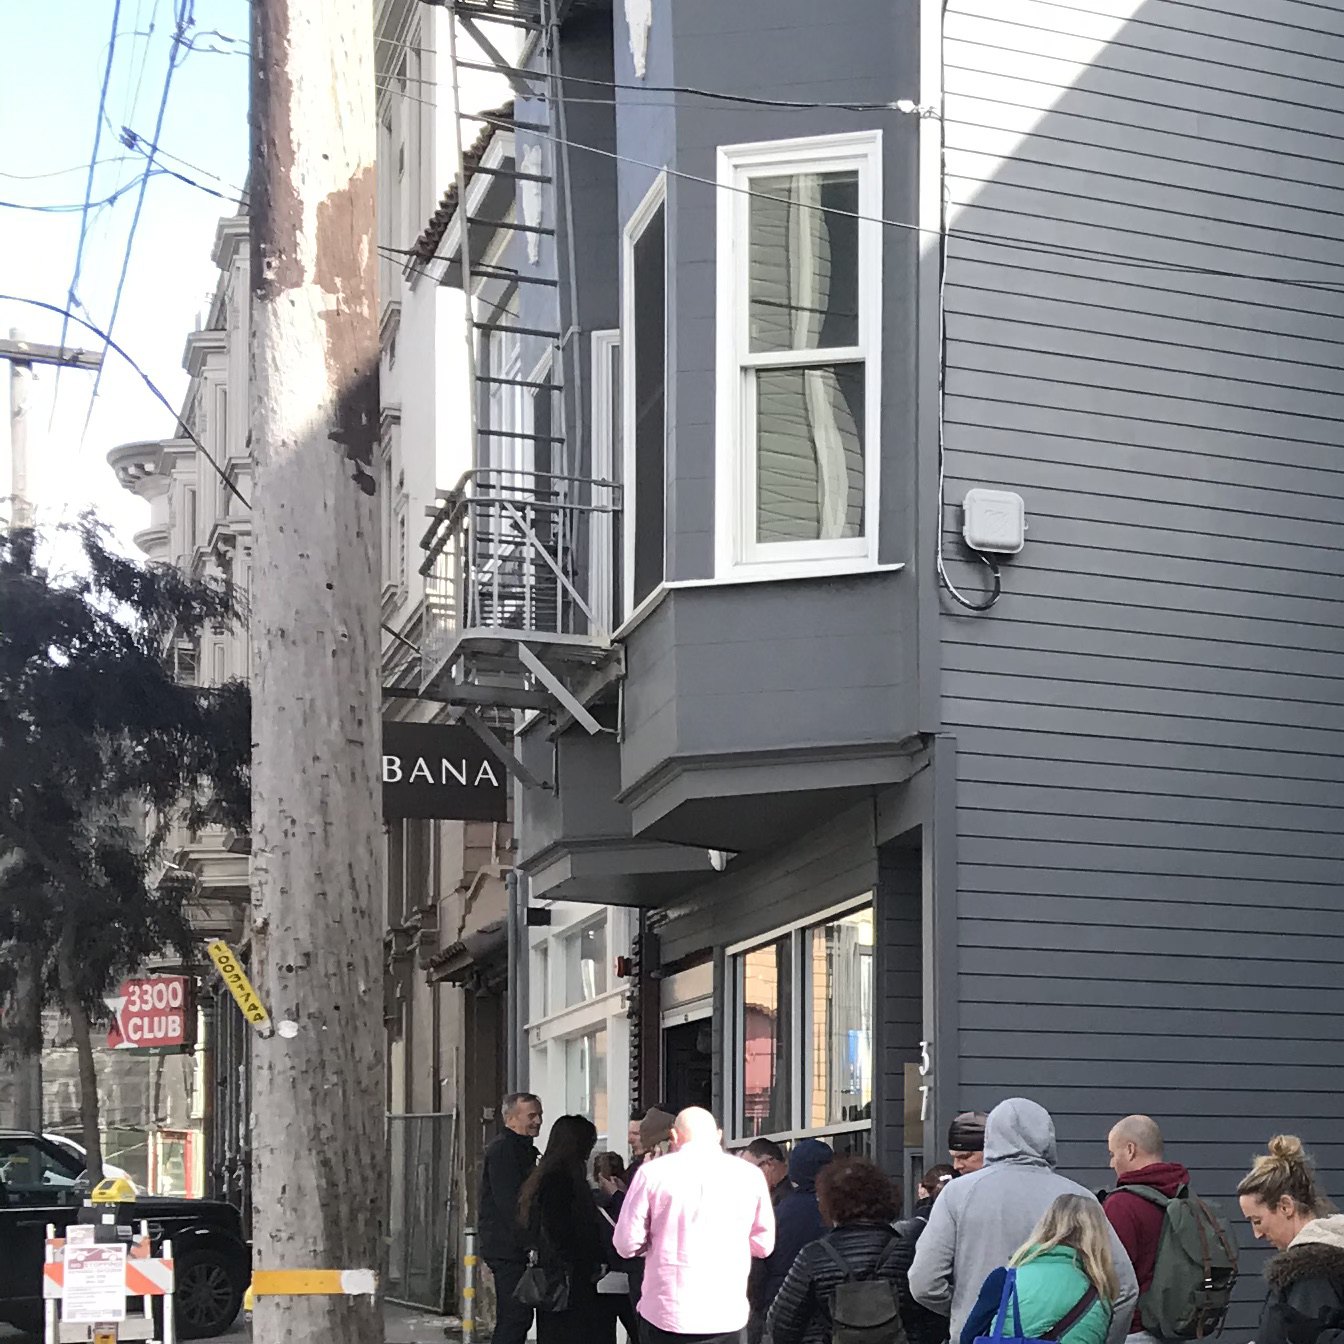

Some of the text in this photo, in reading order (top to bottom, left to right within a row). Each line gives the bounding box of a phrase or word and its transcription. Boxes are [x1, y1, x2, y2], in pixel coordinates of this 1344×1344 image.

[381, 755, 499, 787] BANA
[127, 981, 183, 1013] 3300
[127, 1015, 181, 1041] CLUB
